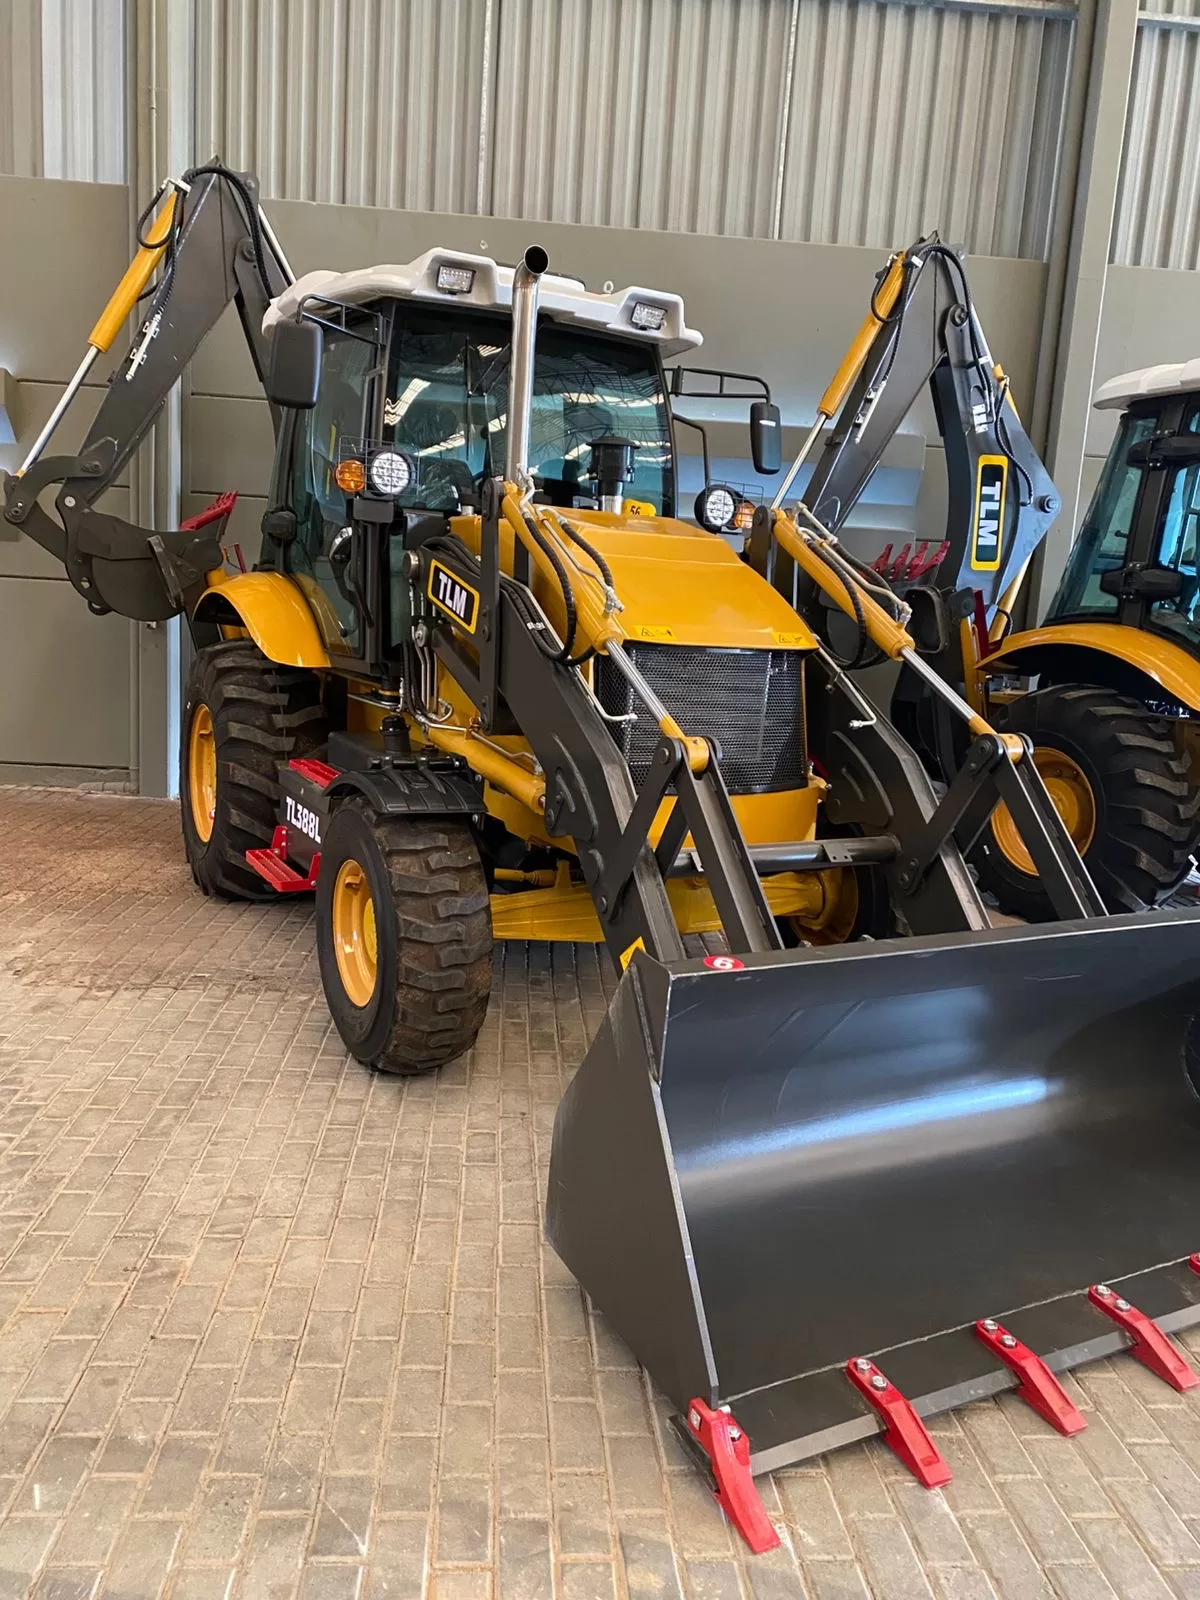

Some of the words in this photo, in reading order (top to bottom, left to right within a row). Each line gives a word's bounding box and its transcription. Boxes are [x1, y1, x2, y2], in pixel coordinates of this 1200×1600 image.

[978, 481, 1001, 546] TLM
[439, 571, 467, 618] TLM
[286, 795, 321, 844] TL388L
[713, 957, 735, 970] 6
